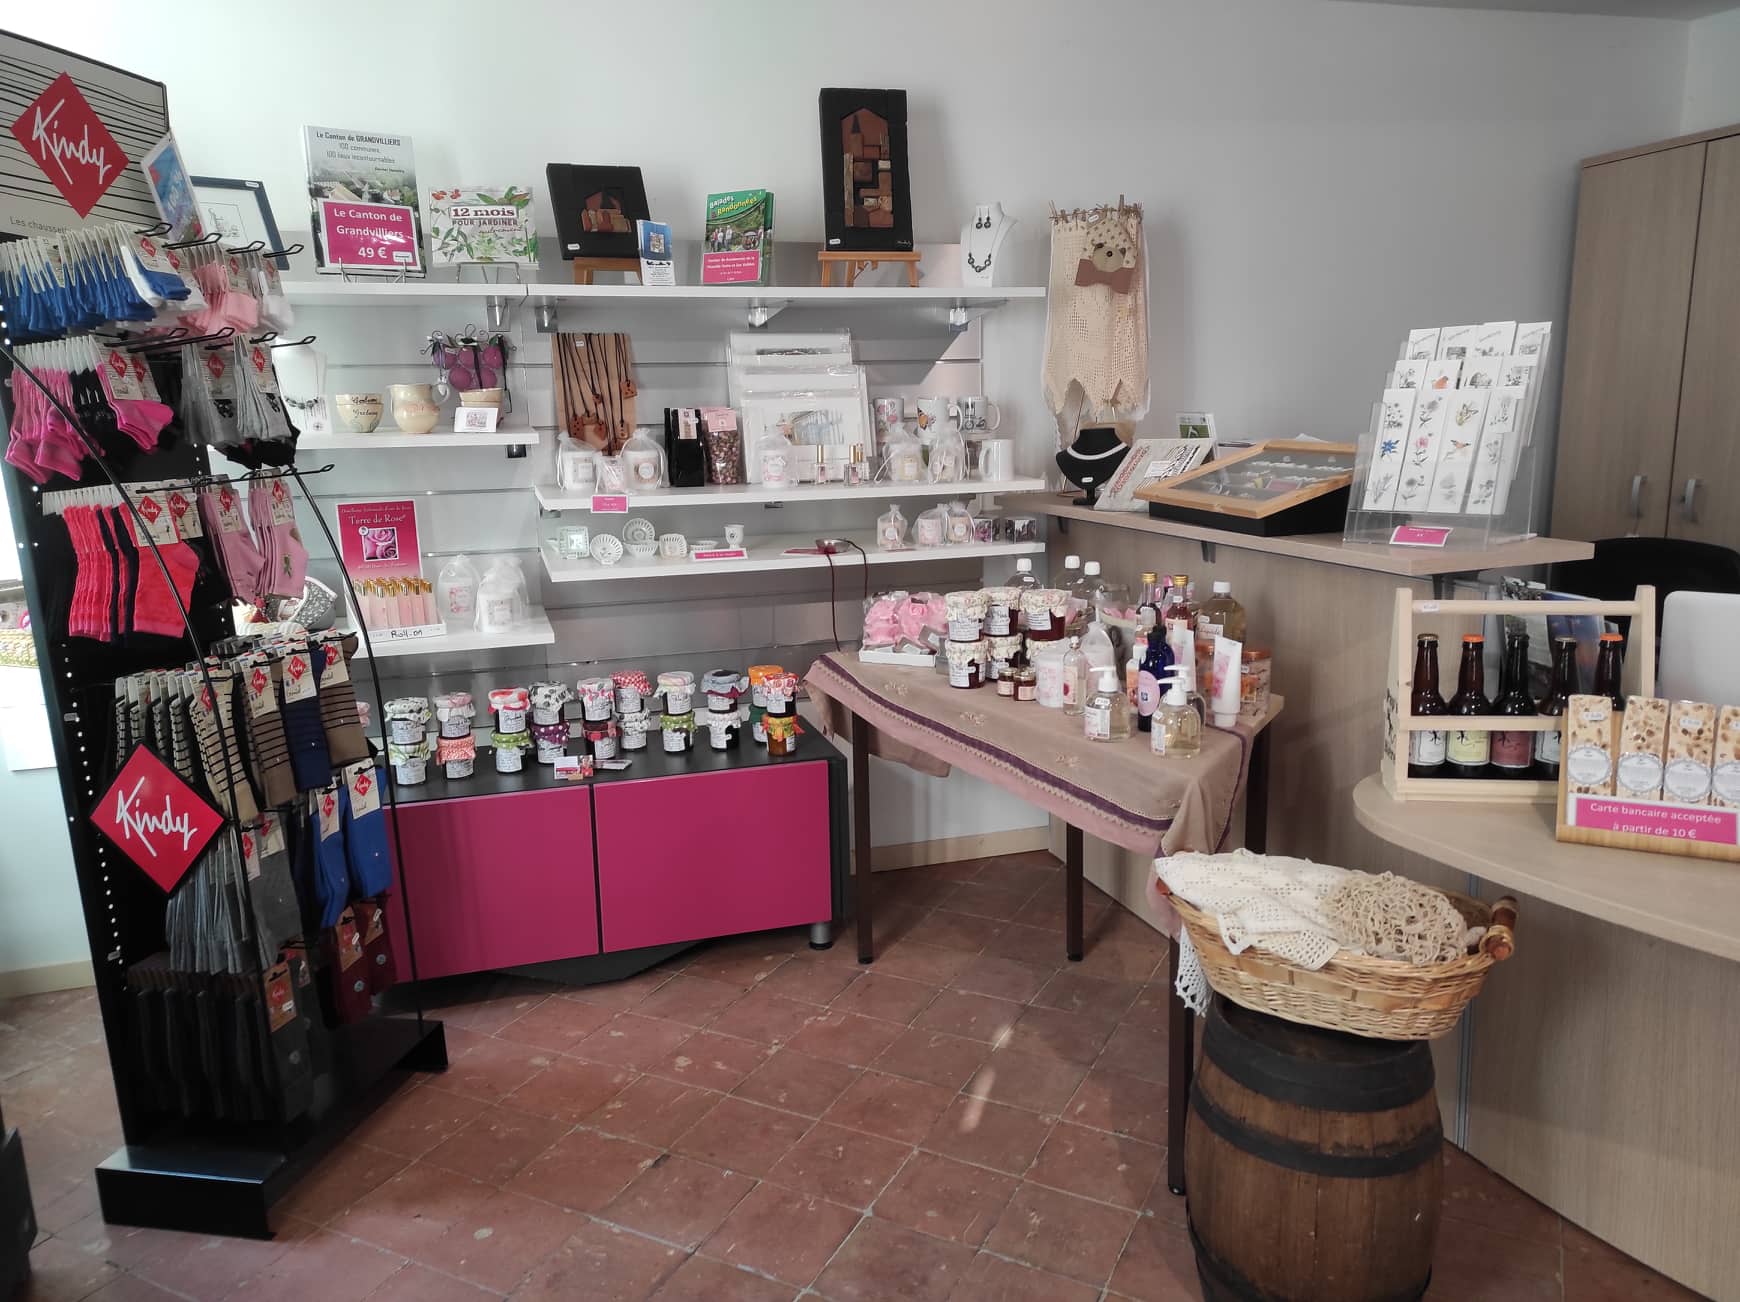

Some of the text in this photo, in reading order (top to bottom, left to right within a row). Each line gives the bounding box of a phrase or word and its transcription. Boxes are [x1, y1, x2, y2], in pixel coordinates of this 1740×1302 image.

[32, 98, 112, 185] Kindy
[334, 208, 403, 222] Le Canton de
[452, 208, 514, 217] 12 mois
[10, 216, 26, 227] Les
[452, 218, 518, 227] POUR JARDINER
[336, 225, 404, 239] Grandvilliers
[358, 247, 387, 259] 49 €
[116, 776, 198, 857] Kindy
[1590, 802, 1721, 825] Carte bancaire acceptée
[1613, 822, 1697, 839] à partir de 10 €
